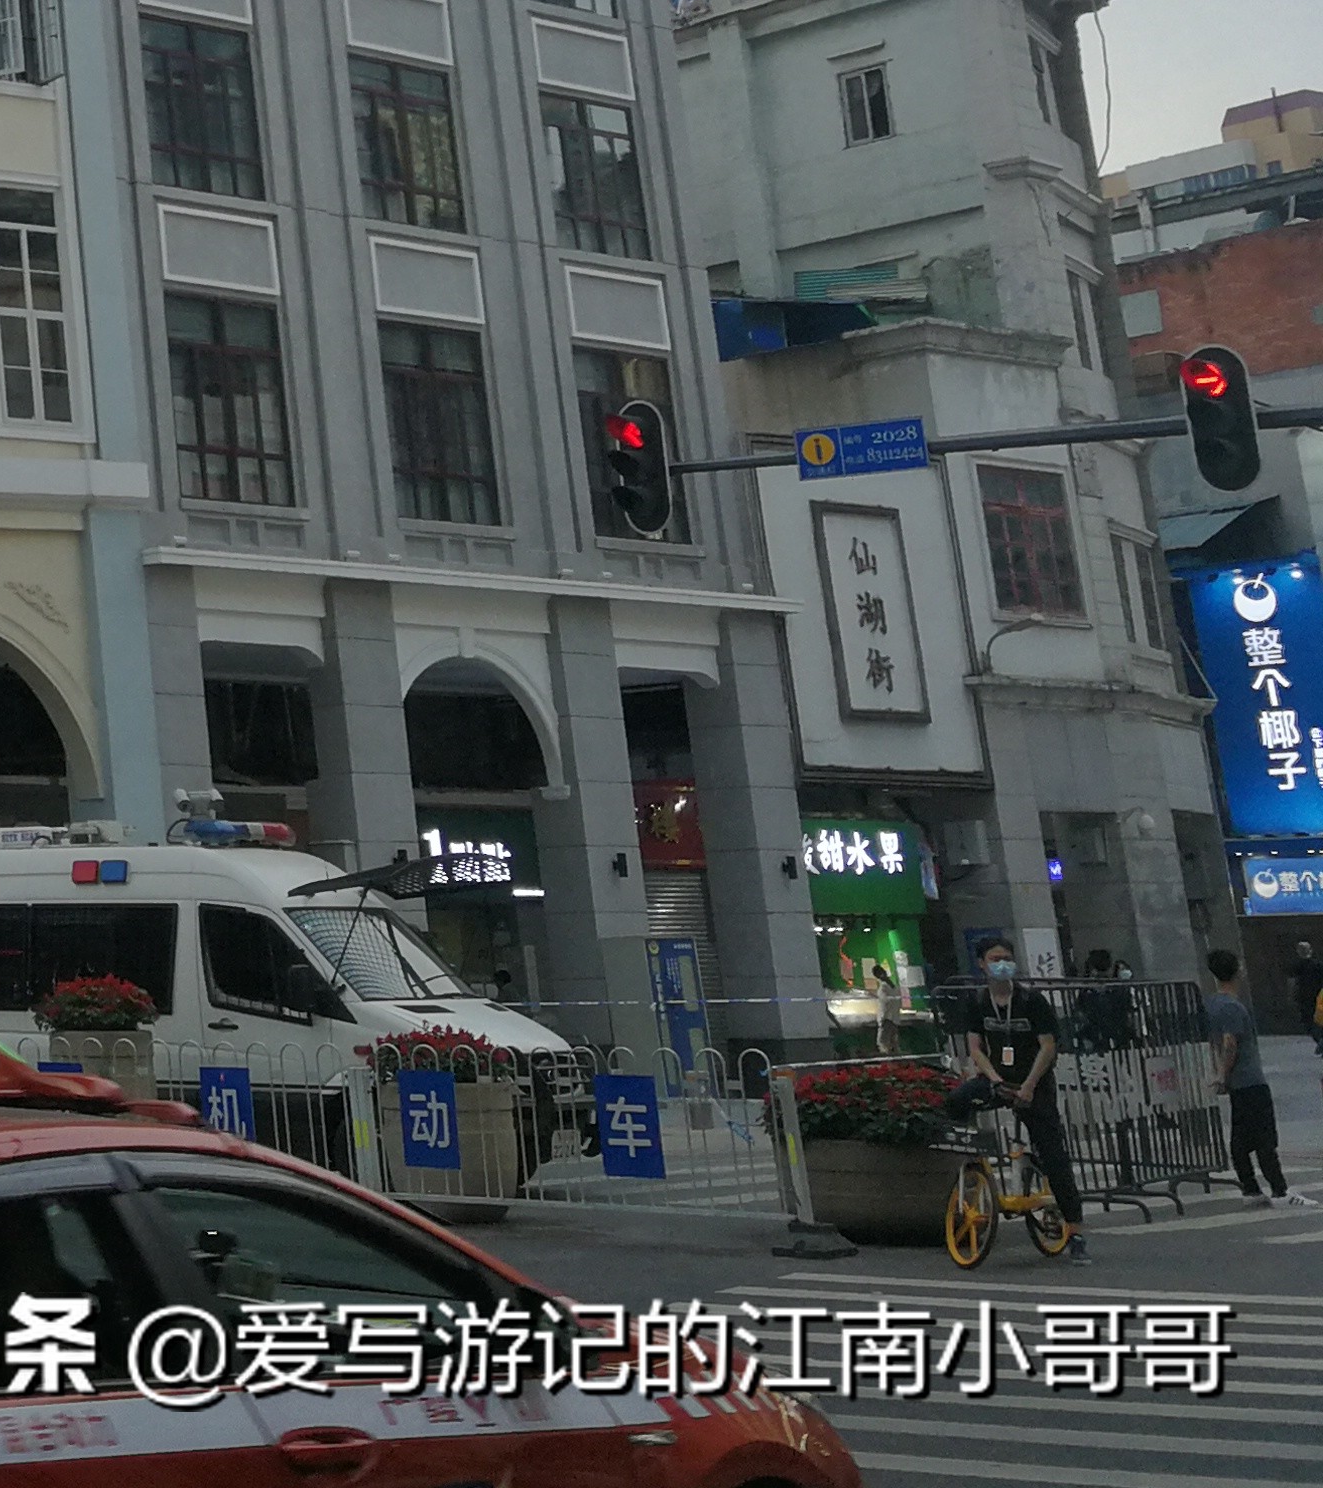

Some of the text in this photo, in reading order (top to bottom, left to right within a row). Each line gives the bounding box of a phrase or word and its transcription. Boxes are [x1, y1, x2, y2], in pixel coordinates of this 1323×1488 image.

[871, 425, 918, 444] 2028
[848, 536, 895, 694] 仙湖街
[1242, 625, 1308, 792] 整个椰子
[1279, 869, 1323, 893] 整个
[207, 1085, 247, 1139] 机
[408, 1089, 451, 1150] 动
[605, 1095, 652, 1158] 车
